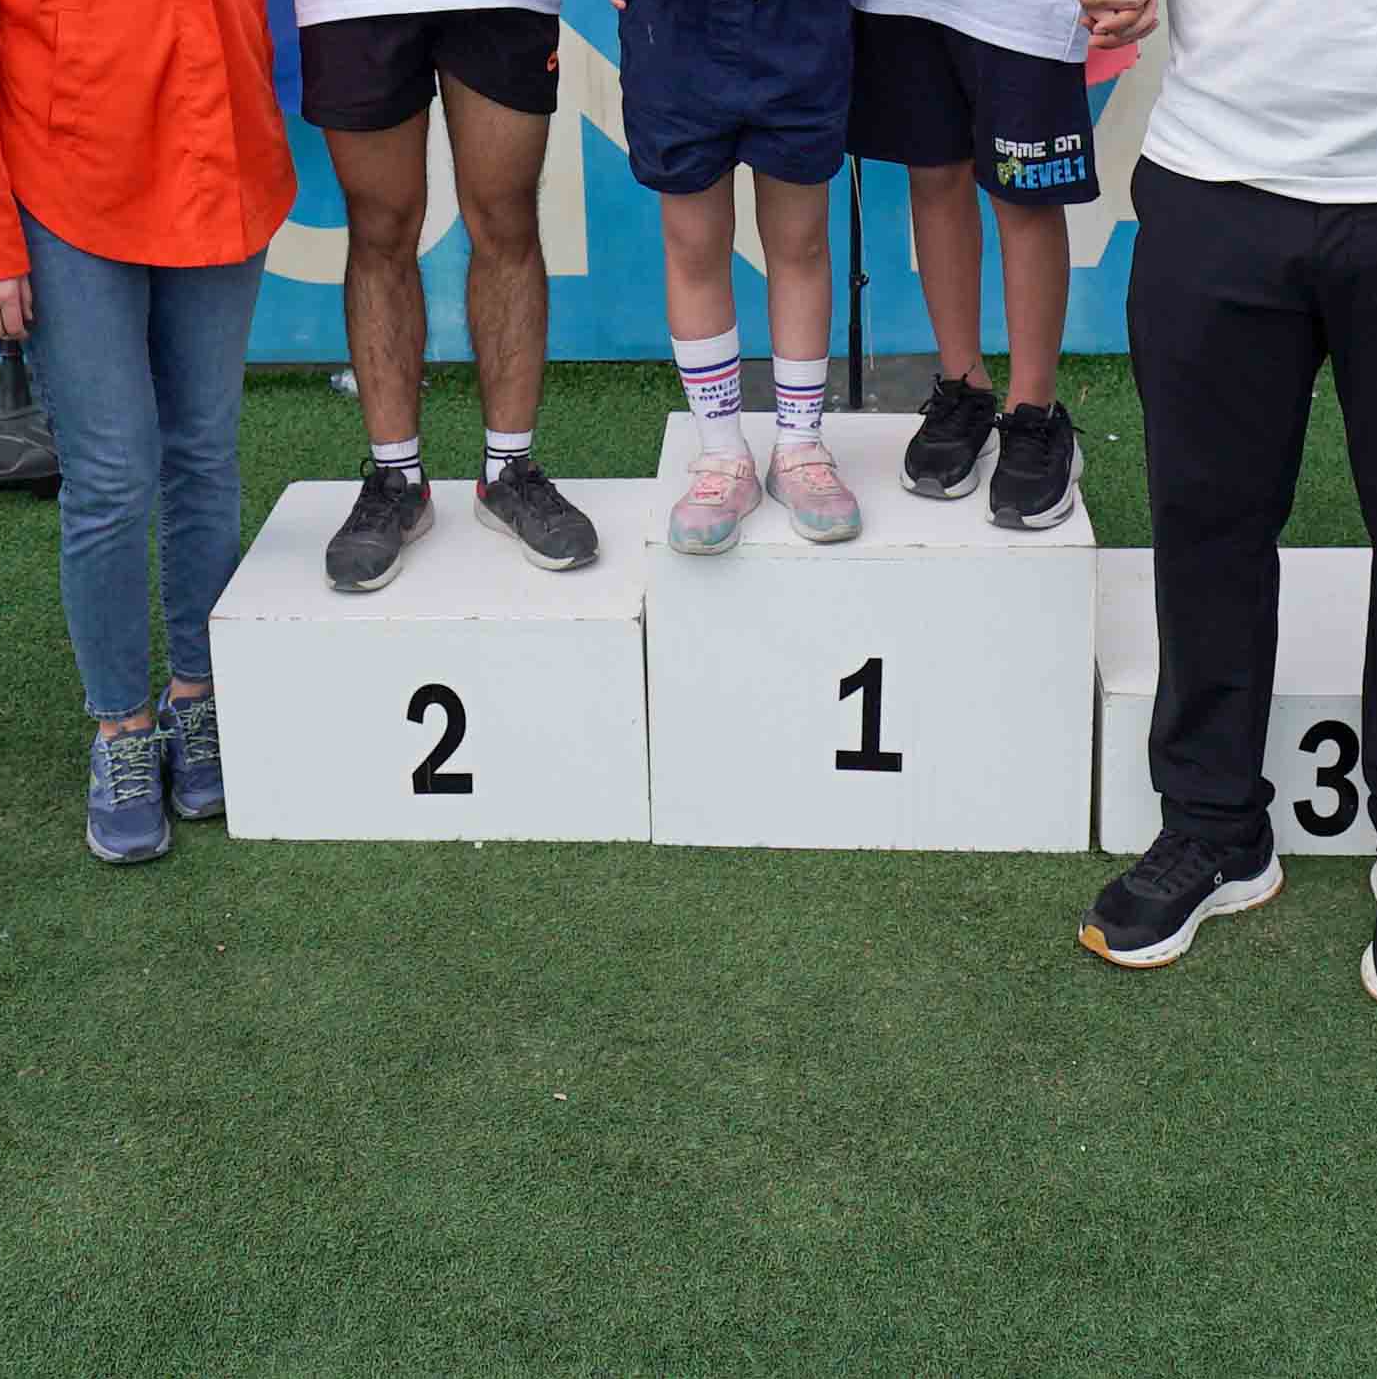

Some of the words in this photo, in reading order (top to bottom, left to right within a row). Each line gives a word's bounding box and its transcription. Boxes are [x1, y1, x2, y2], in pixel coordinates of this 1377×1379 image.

[995, 137, 1046, 159] GAME
[405, 684, 474, 796] 2
[835, 658, 903, 773] 1
[1293, 720, 1361, 837] 3
